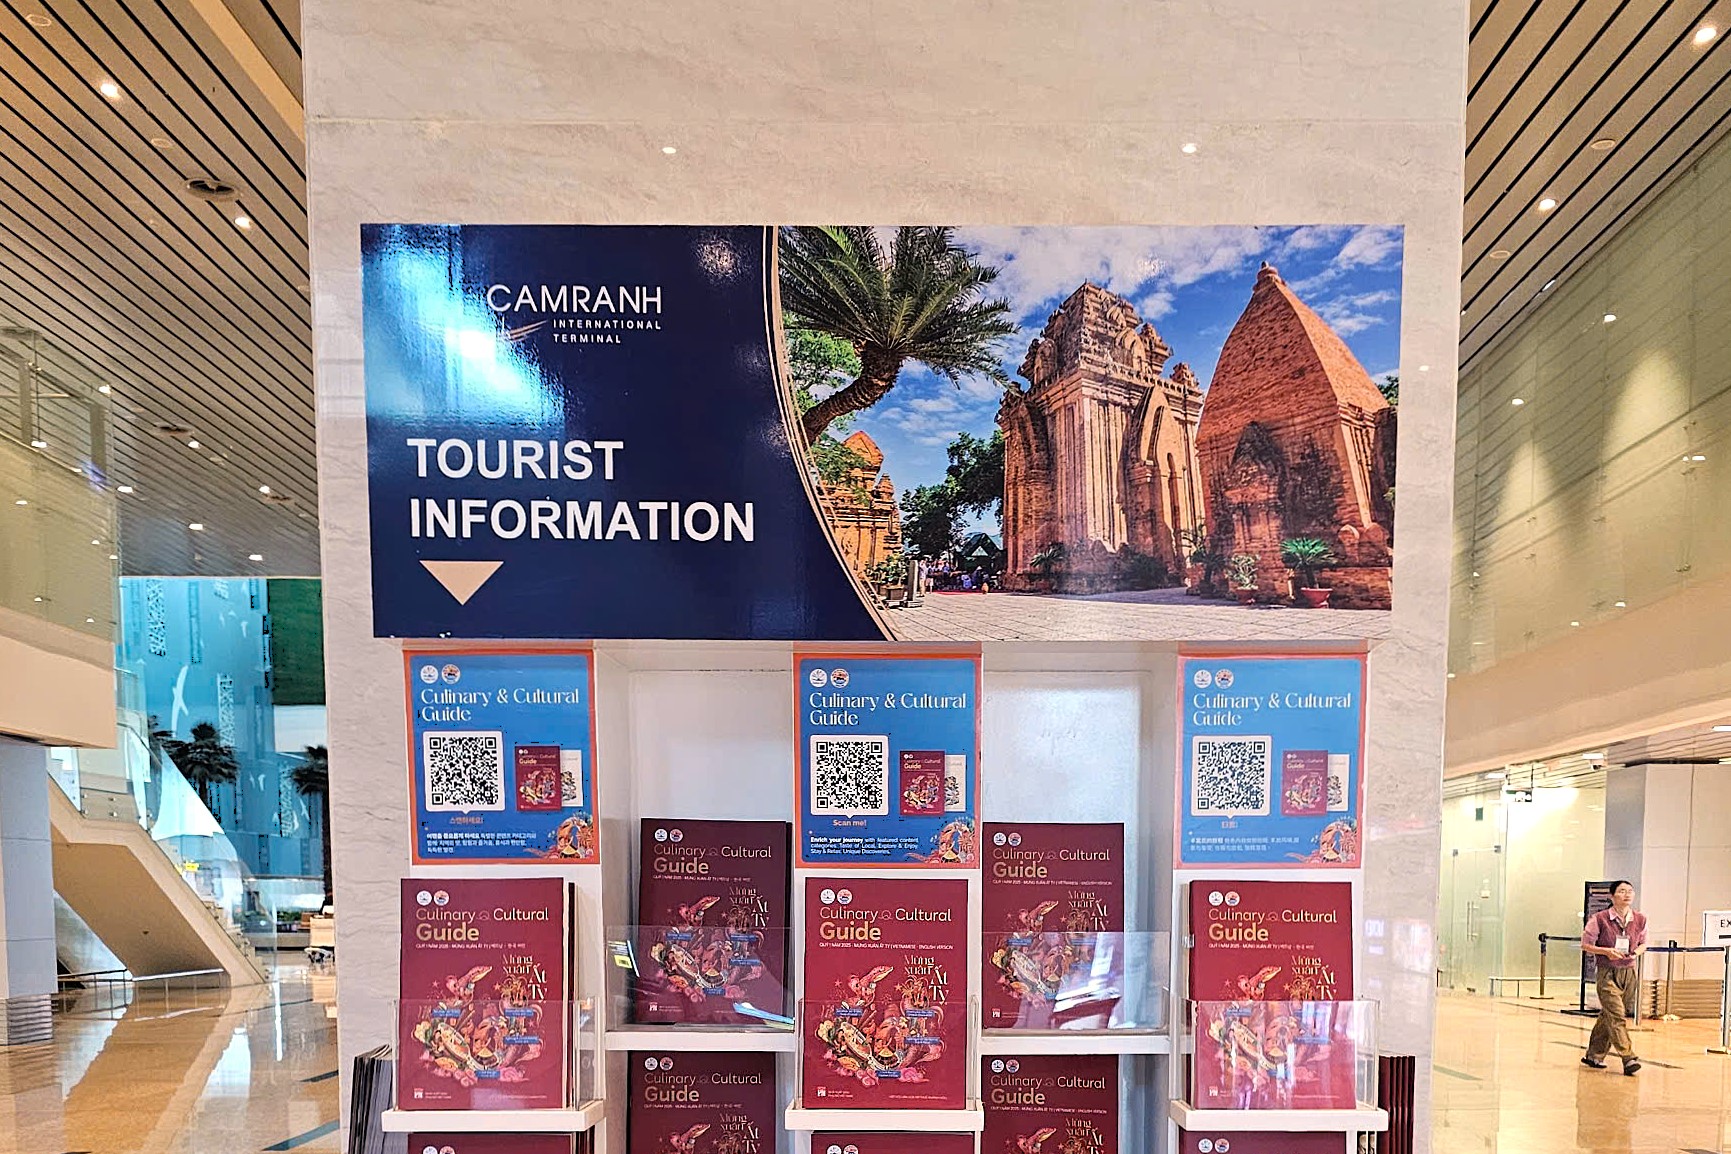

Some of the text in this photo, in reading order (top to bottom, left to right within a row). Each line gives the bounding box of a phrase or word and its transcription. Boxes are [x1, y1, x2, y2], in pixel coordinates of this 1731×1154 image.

[487, 284, 662, 314] CAMRANH
[553, 319, 661, 329] INTERNATIONAL
[553, 334, 621, 343] TERMINAL
[407, 439, 624, 481] TOURIST
[409, 499, 755, 542] INFORMATION
[421, 688, 579, 706] Culinary & Cultural
[810, 693, 966, 711] Culinary & Cultural
[1193, 693, 1351, 711] Culinary & Cultural
[422, 706, 471, 721] Guide
[810, 710, 859, 725] Guide
[1193, 711, 1242, 726] Guide
[654, 844, 771, 859] Culinary Cultural
[993, 848, 1110, 862] Culinary Cultural
[654, 857, 709, 874] Guide
[993, 861, 1047, 878] Guide
[416, 908, 548, 924] Culinary Cultural
[820, 906, 951, 923] Culinary Cultural
[1209, 908, 1337, 924] Culinary Cultural
[416, 922, 479, 941] Guide
[820, 921, 881, 940] Guide
[1209, 923, 1268, 941] Guide
[644, 1072, 761, 1086] Culinary Cultural
[991, 1075, 1105, 1089] Culinary Cultural
[645, 1085, 699, 1102] Guide
[991, 1088, 1045, 1104] Guide
